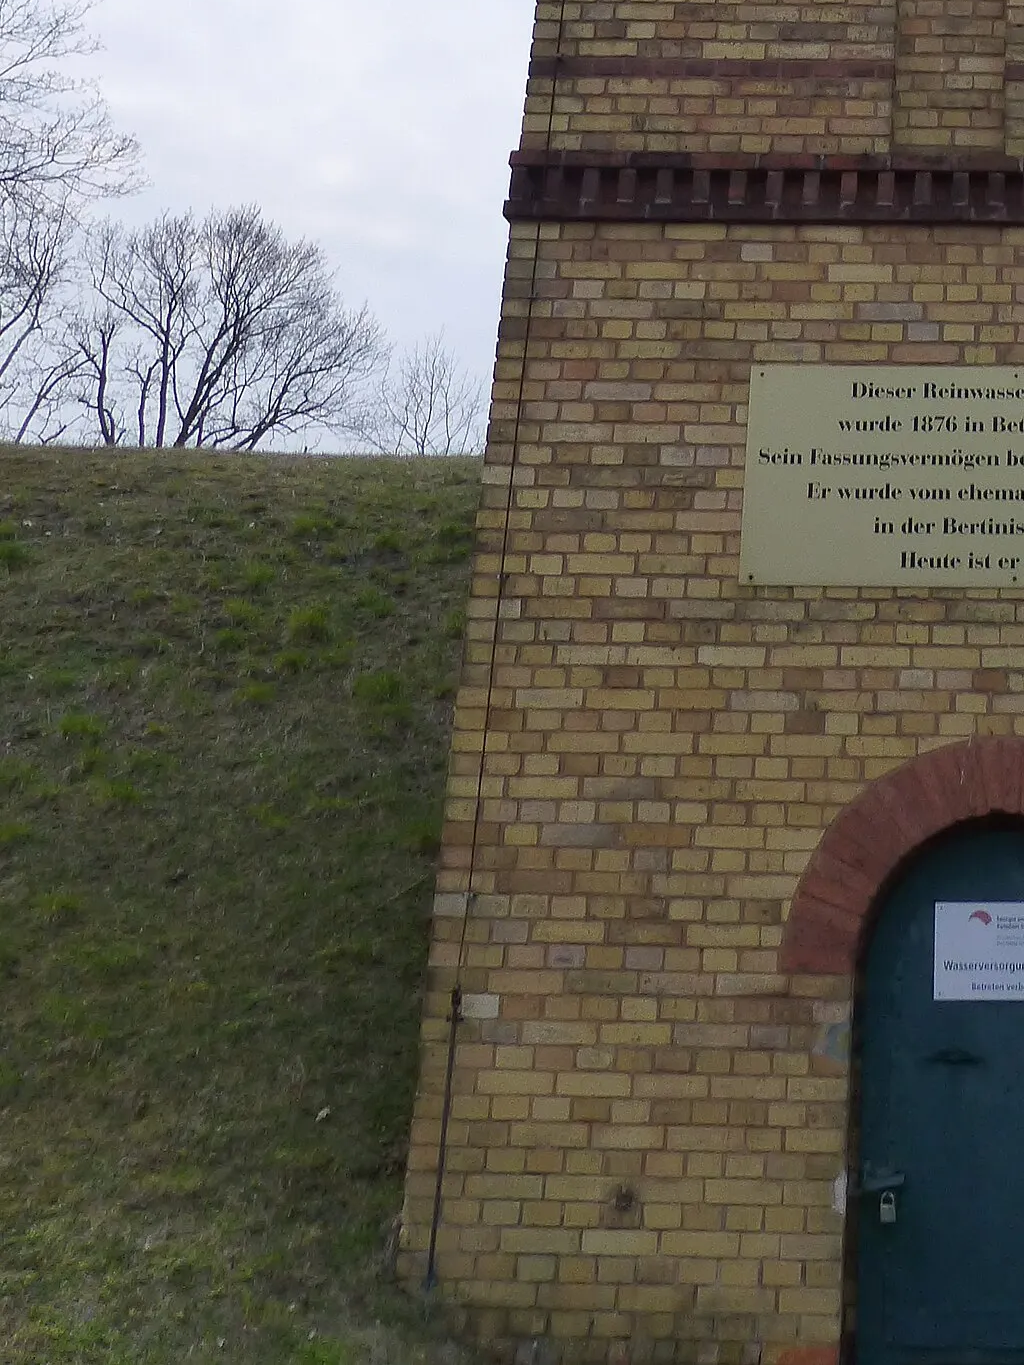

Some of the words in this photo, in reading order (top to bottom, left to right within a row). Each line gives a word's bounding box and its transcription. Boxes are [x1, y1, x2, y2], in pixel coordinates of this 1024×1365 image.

[851, 381, 917, 400] Dieser
[838, 414, 903, 435] wurde
[910, 414, 958, 434] 1876
[964, 415, 984, 433] in
[758, 447, 805, 466] Sein
[809, 447, 1000, 471] Fassungsvermögen
[807, 482, 832, 501] Er
[837, 482, 903, 501] wurde
[908, 487, 951, 501] vom
[873, 516, 894, 535] in
[901, 516, 936, 535] der
[900, 550, 962, 572] Heute
[968, 551, 993, 571] ist
[998, 555, 1020, 572] er
[971, 981, 1005, 992] Betreten
